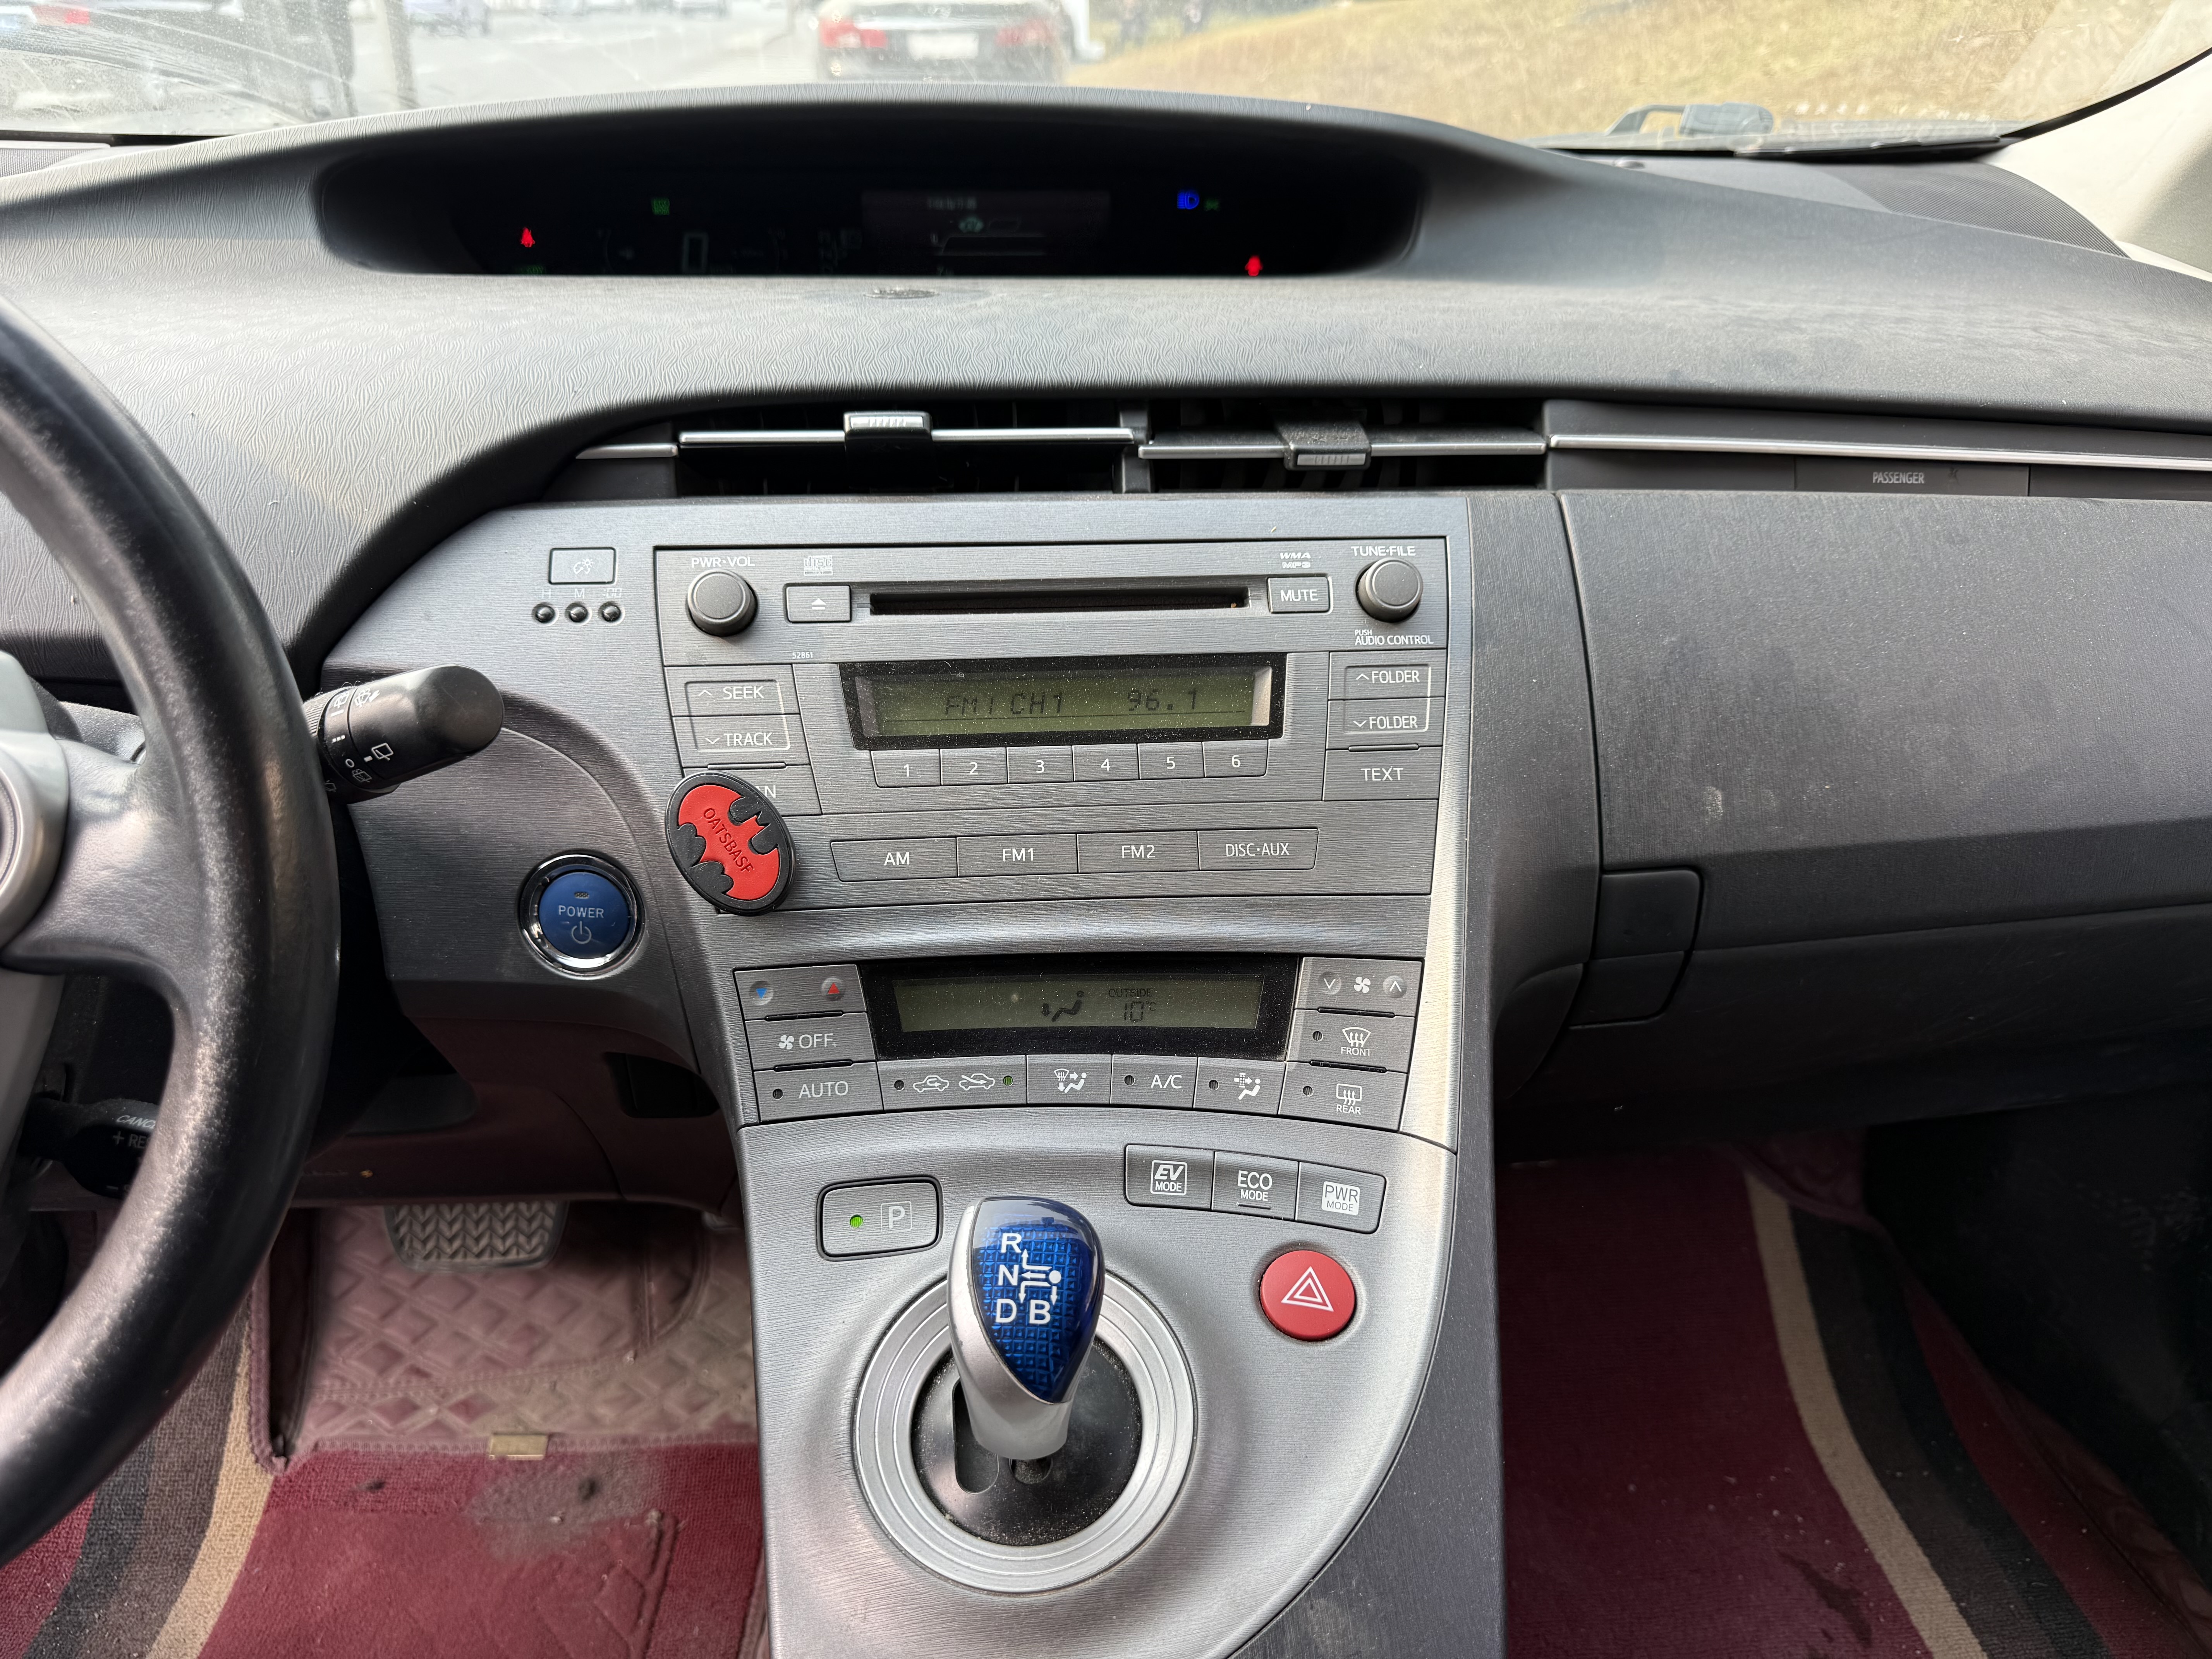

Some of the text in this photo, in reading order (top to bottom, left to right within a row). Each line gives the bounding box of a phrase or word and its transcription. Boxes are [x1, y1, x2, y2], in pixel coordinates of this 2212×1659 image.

[1873, 472, 1924, 484] PASSENGER
[541, 589, 551, 599] H
[575, 588, 585, 598] M
[1280, 589, 1318, 601] MUTE
[1355, 635, 1434, 645] AUDIO CONTROL
[1372, 670, 1420, 683] FOLDER
[723, 686, 764, 700] SEEK
[1010, 692, 1063, 714] CH1
[1127, 689, 1197, 711] 96.1
[1369, 716, 1417, 729] FOLDER
[724, 732, 773, 747] TRACK
[1036, 760, 1045, 773] 3
[1100, 759, 1111, 772] 4
[1166, 757, 1175, 770] 5
[1231, 754, 1241, 768] 6
[903, 764, 910, 777] 1
[969, 762, 979, 776] 2
[1360, 768, 1403, 781] TEXT
[1002, 848, 1034, 862] FM1
[1121, 845, 1156, 859] FM2
[884, 852, 910, 866] AM
[558, 905, 604, 918] POWER
[1109, 988, 1153, 997] OUTSIDE
[799, 1033, 833, 1049] OFF
[1340, 1046, 1371, 1056] FRONT
[1151, 1074, 1182, 1089] A/C
[799, 1081, 848, 1099] AUTO
[1336, 1104, 1361, 1115] REAR
[1154, 1164, 1183, 1180] EV
[1237, 1170, 1273, 1190] ECO
[1155, 1182, 1182, 1192] MODE
[1324, 1184, 1358, 1203] PWR
[1240, 1190, 1268, 1202] MODE
[1326, 1201, 1353, 1212] MODE
[888, 1205, 905, 1229] P
[1001, 1233, 1021, 1254] R
[998, 1264, 1018, 1286] N
[996, 1298, 1017, 1323] D
[1029, 1300, 1051, 1324] B
